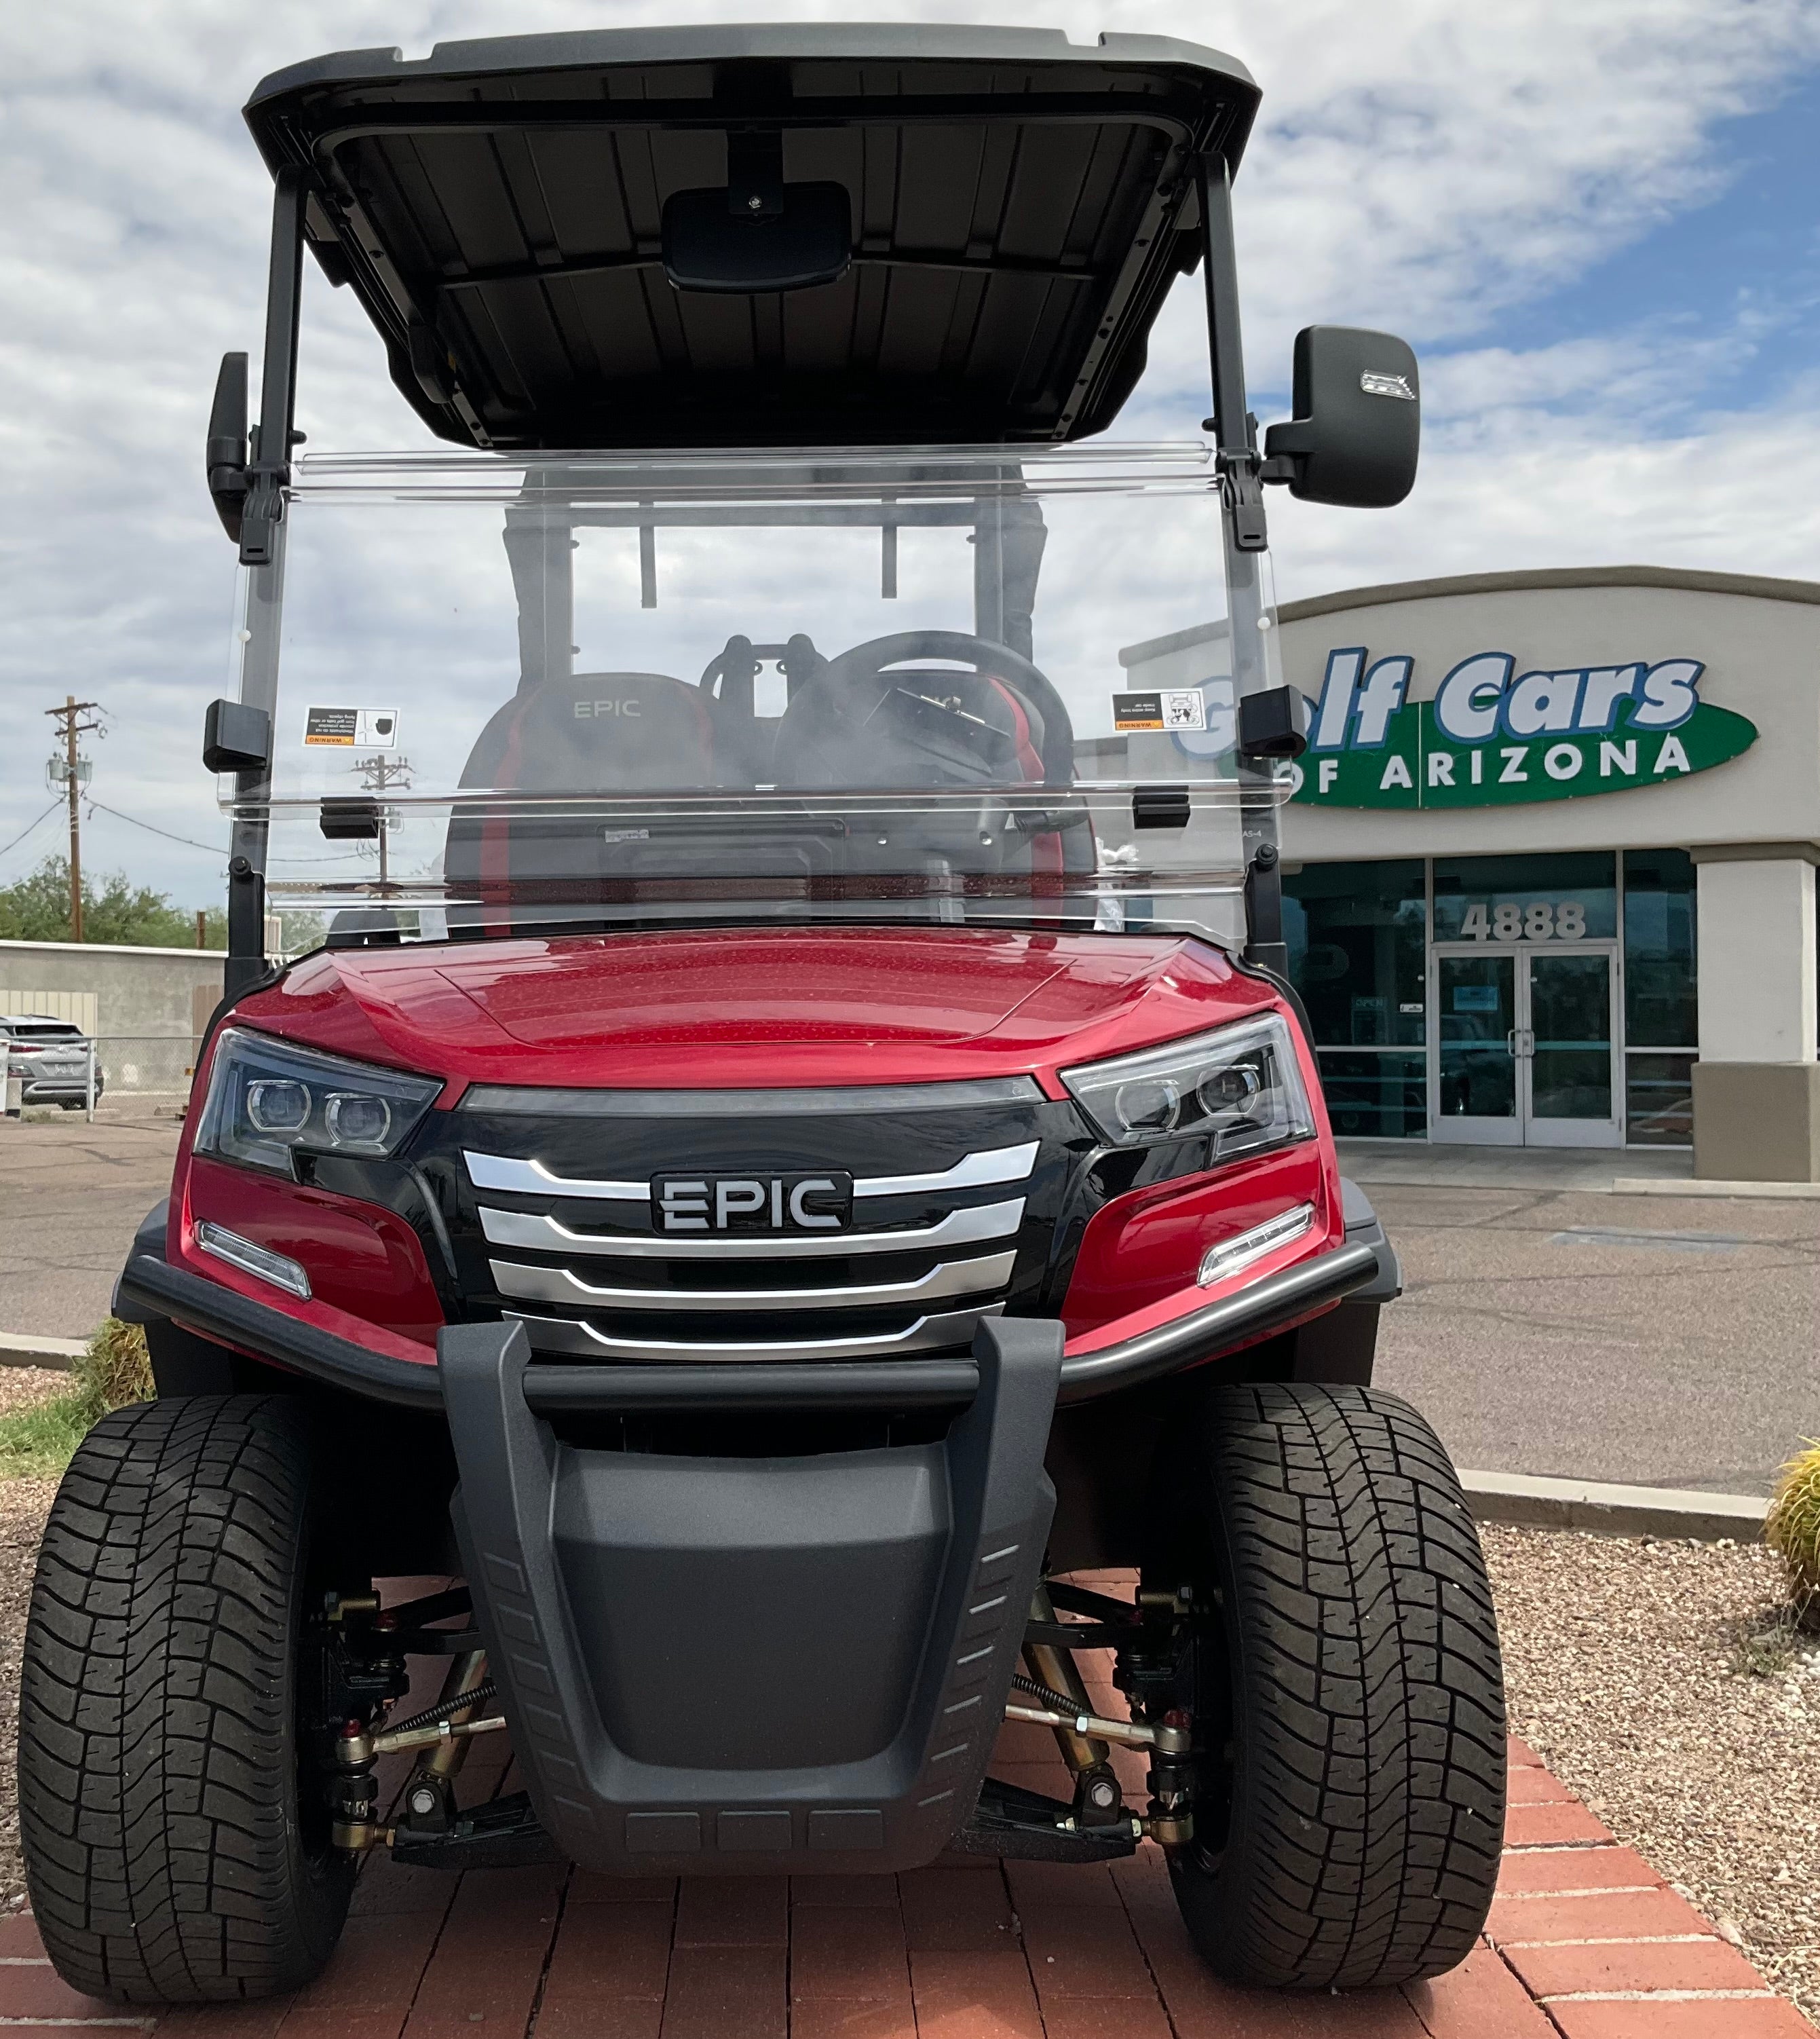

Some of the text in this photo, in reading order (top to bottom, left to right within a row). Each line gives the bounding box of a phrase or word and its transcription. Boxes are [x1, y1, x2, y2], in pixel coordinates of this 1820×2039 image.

[574, 700, 641, 718] EPIC
[1171, 646, 1706, 761] Glf Cars
[1266, 732, 1690, 796] OF ARIZONA
[1460, 902, 1586, 941] 4888
[658, 1179, 842, 1229] EPIC
